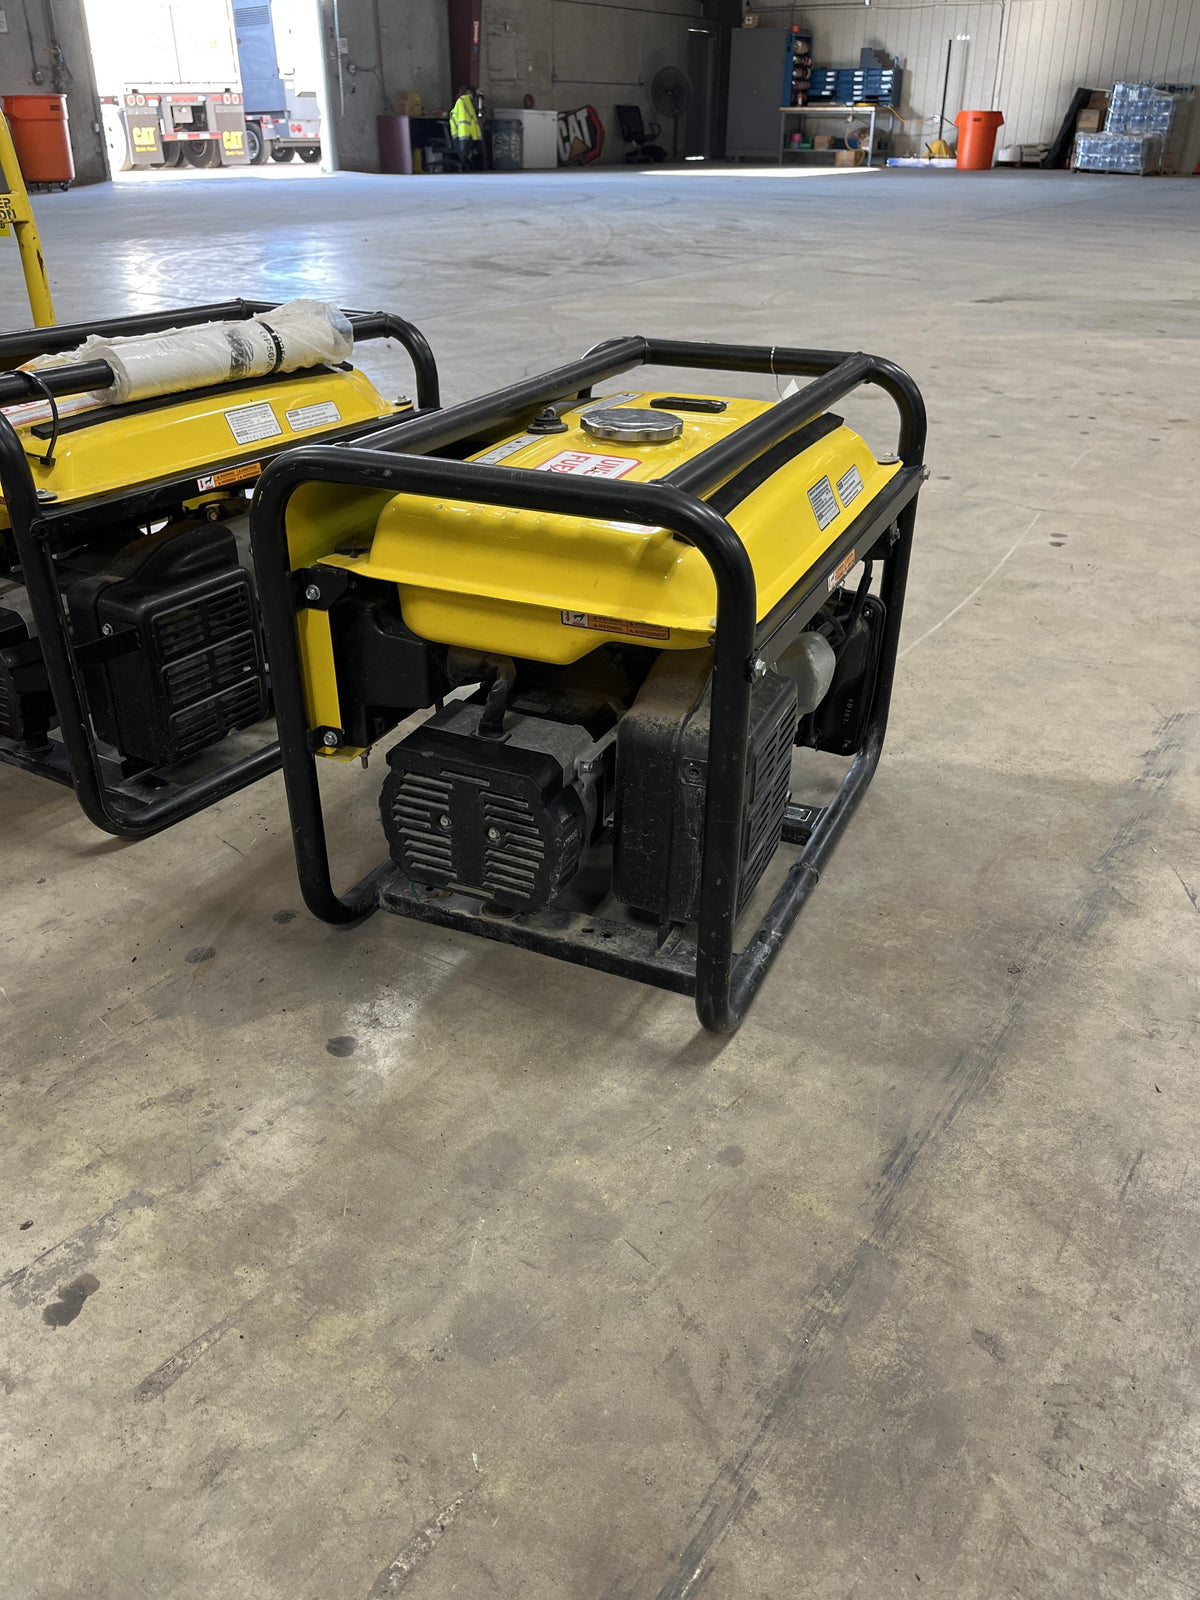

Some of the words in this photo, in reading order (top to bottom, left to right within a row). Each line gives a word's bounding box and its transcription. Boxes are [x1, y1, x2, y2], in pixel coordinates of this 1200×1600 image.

[132, 126, 156, 145] CAT
[222, 131, 243, 149] CAT
[558, 109, 592, 161] CAT
